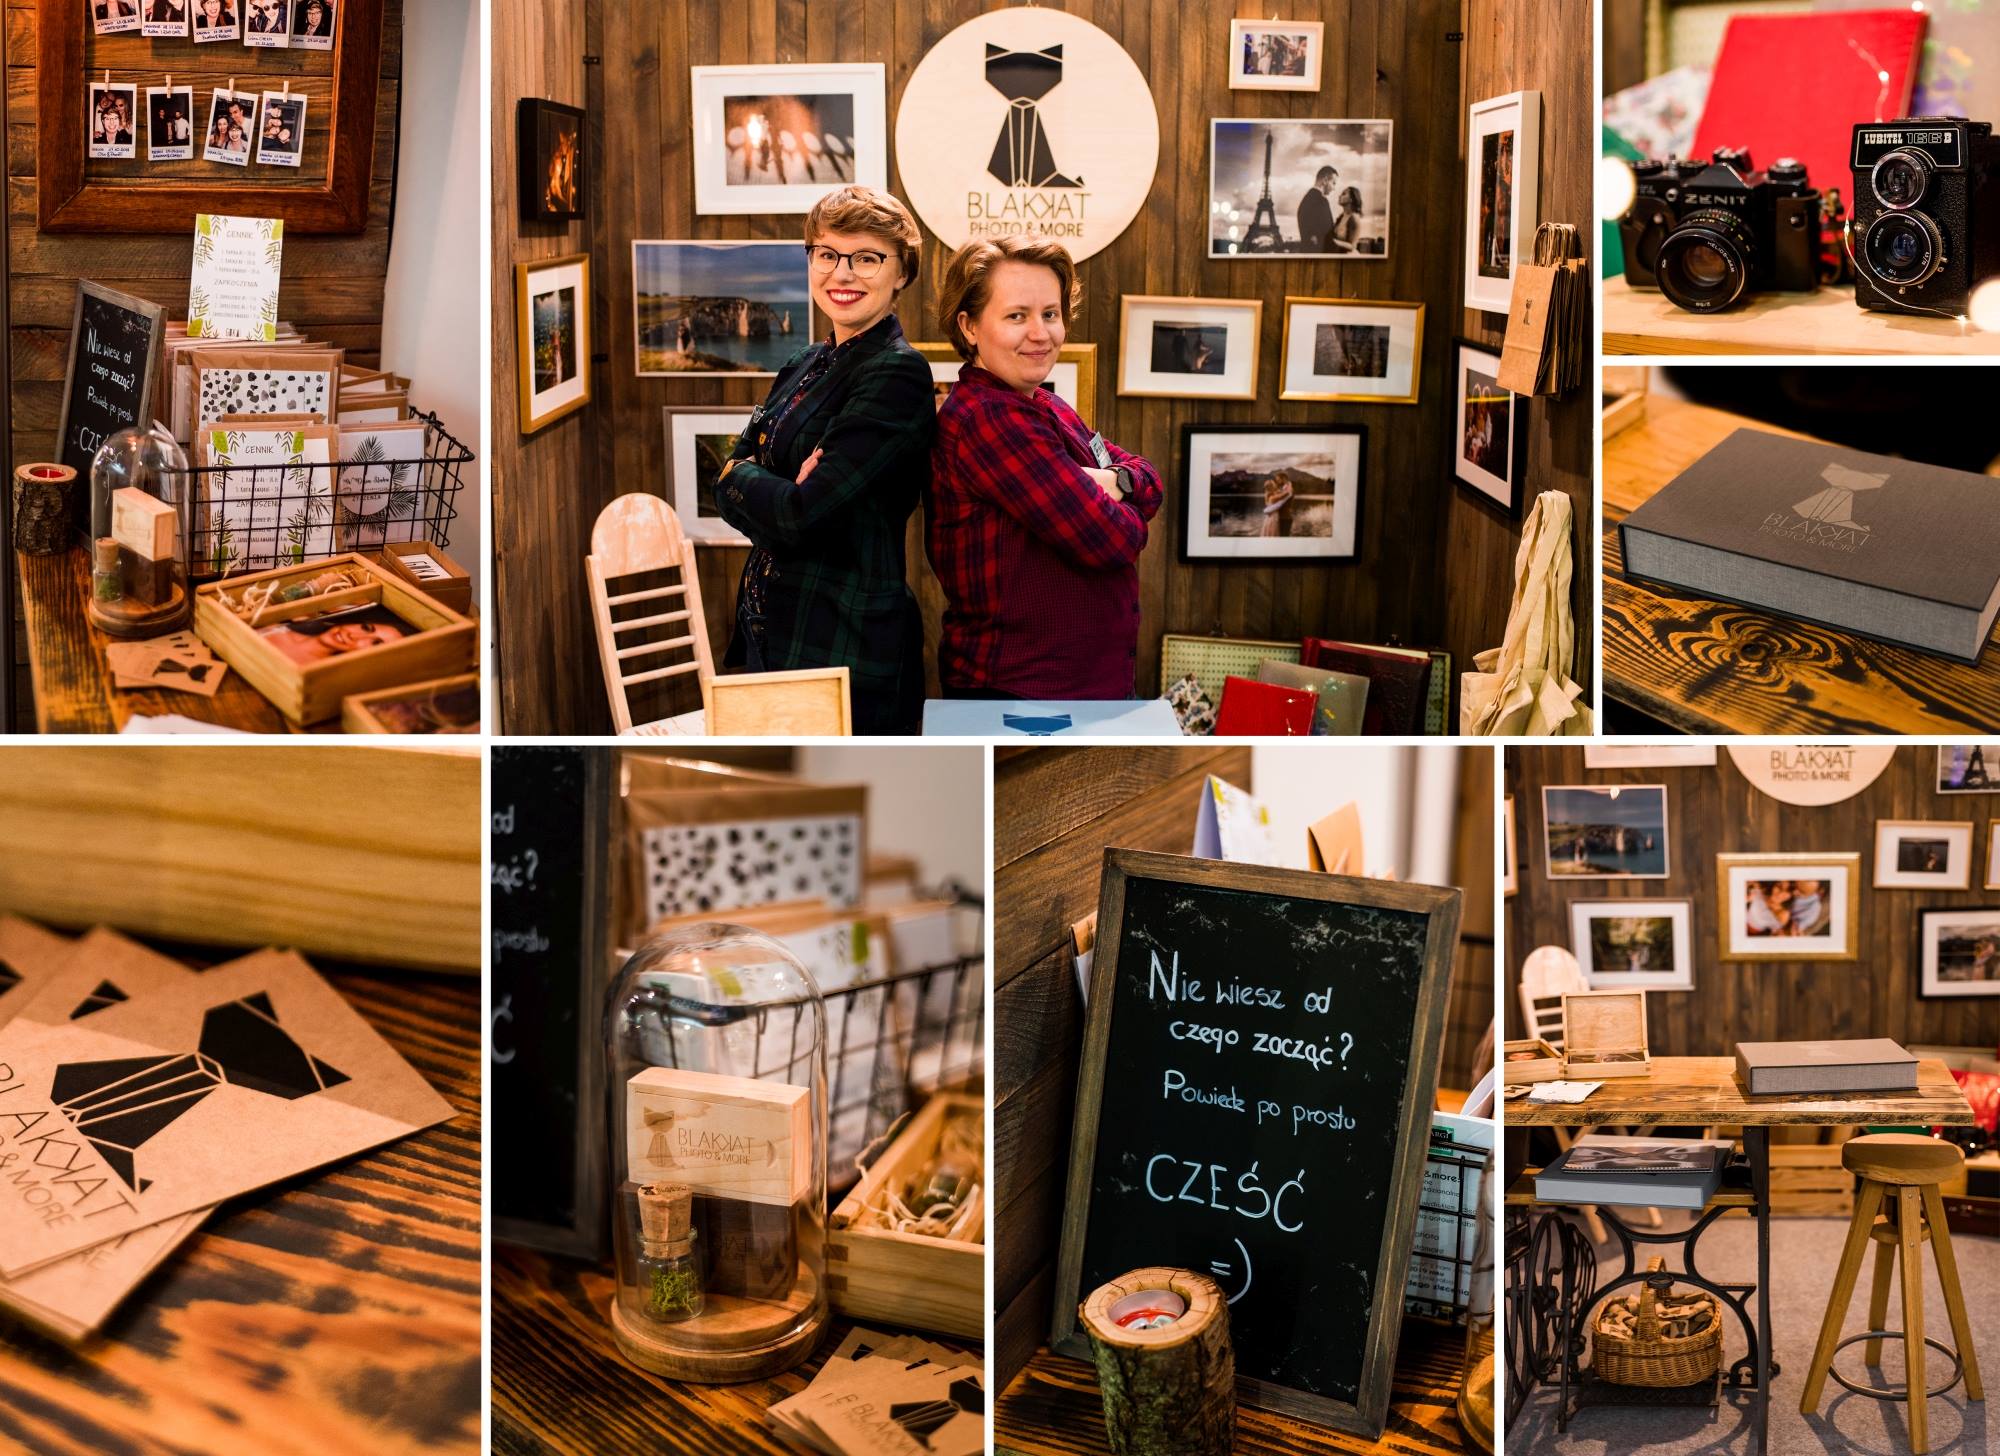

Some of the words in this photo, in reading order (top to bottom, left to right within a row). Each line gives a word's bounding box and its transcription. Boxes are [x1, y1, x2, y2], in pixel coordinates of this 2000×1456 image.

[1864, 132, 1903, 145] LUBITEL
[967, 191, 1092, 220] BLAKKAT
[1684, 193, 1747, 205] ZENIT
[969, 222, 1022, 237] PHOTO
[1026, 222, 1038, 236] &
[1040, 222, 1084, 237] MORE
[87, 328, 102, 354] Nie
[103, 342, 121, 361] wiesz
[124, 351, 132, 364] od
[91, 362, 109, 381] czego
[109, 403, 116, 417] po
[245, 446, 274, 454] CENNIK
[1758, 525, 1805, 545] PHOTO
[1807, 536, 1816, 545] &
[1818, 539, 1857, 554] MORE
[1763, 512, 1876, 547] BLAKKAT
[1770, 750, 1856, 770] BLAKKAT
[1772, 771, 1808, 781] PHOTO
[1810, 771, 1819, 781] &
[1820, 771, 1851, 781] MORE
[1149, 950, 1206, 1002] Nie
[1216, 976, 1286, 1011] wiesz
[1304, 987, 1333, 1014] od
[1169, 1020, 1239, 1054] czego
[1252, 1032, 1355, 1071] zacząć?
[1163, 1069, 1246, 1112] Powiedz
[1257, 1099, 1281, 1124] po
[1292, 1104, 1356, 1136] prostu
[678, 1127, 756, 1154] BLAKKAT
[680, 1147, 713, 1160] PHOTO
[714, 1152, 721, 1160] &
[722, 1154, 752, 1166] MORE
[7, 1169, 79, 1230] MORE
[1145, 1154, 1305, 1233] CZEŚĆ
